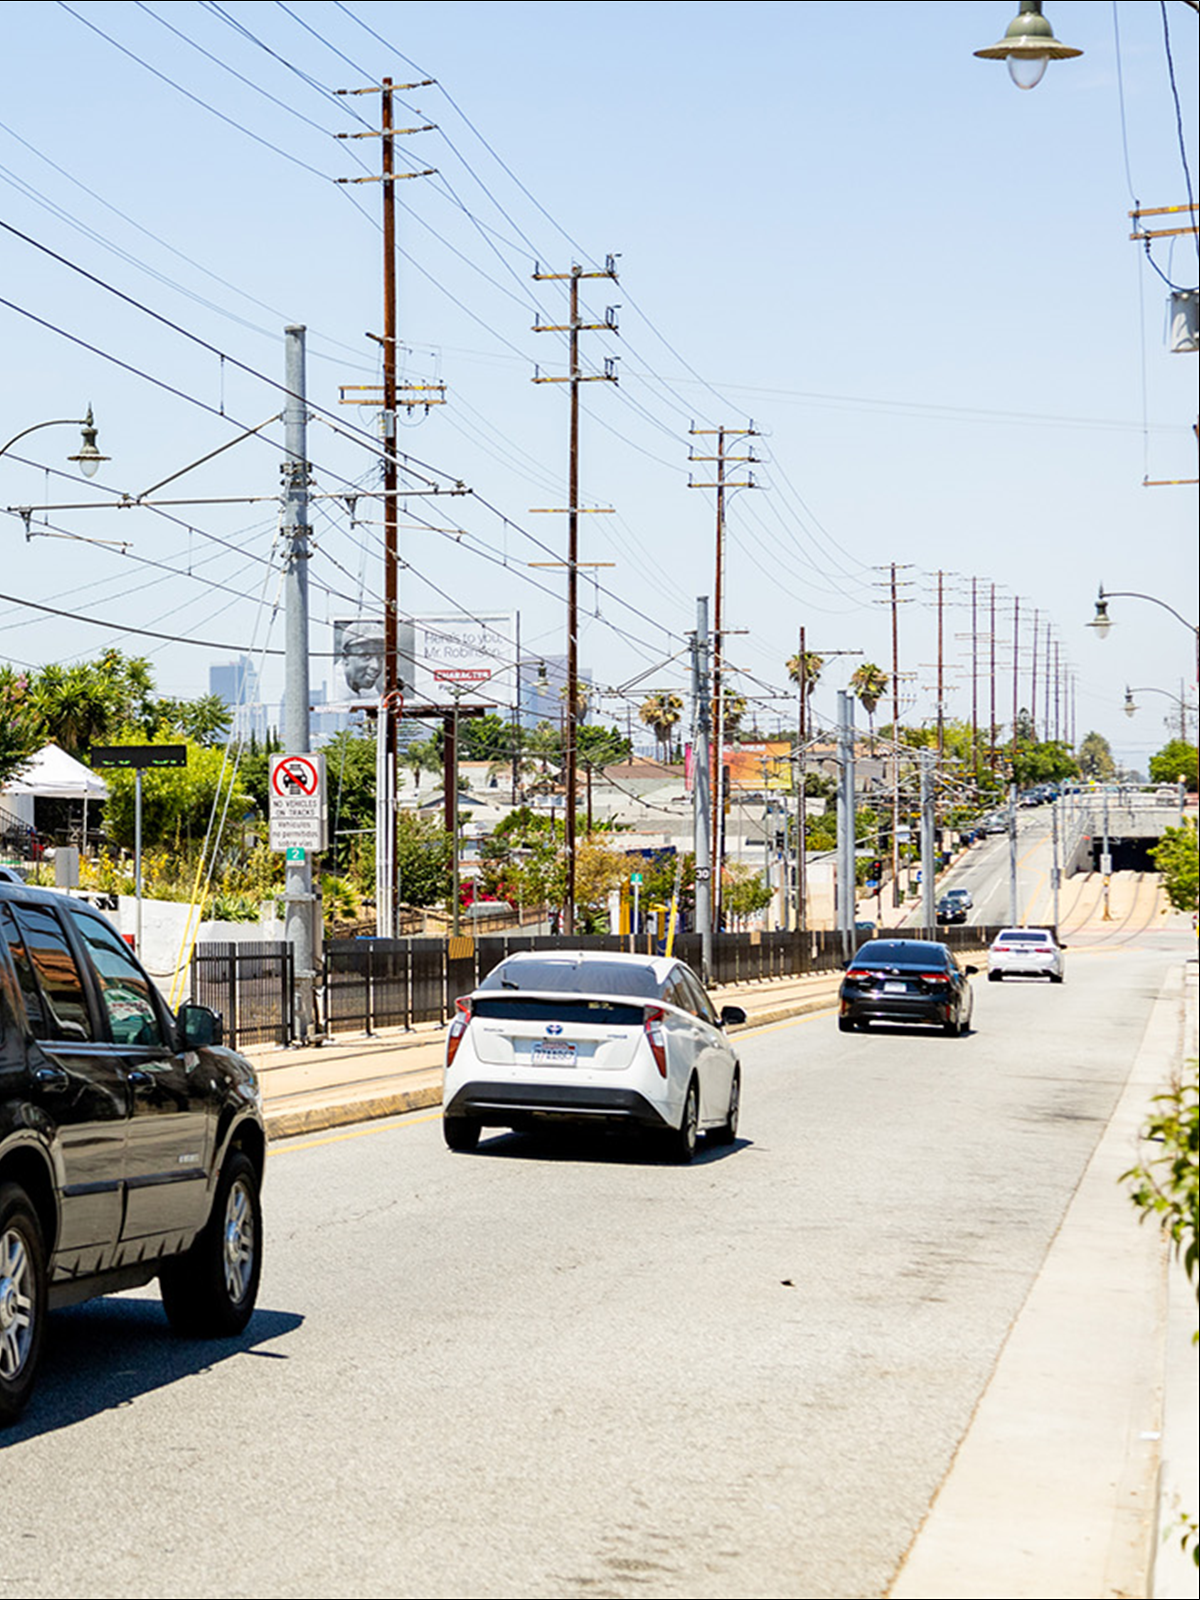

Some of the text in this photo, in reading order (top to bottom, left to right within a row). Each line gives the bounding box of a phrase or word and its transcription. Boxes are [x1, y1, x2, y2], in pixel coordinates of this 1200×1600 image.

[273, 800, 317, 808] NO VEHICLES
[291, 849, 300, 860] 2
[696, 869, 709, 879] 30
